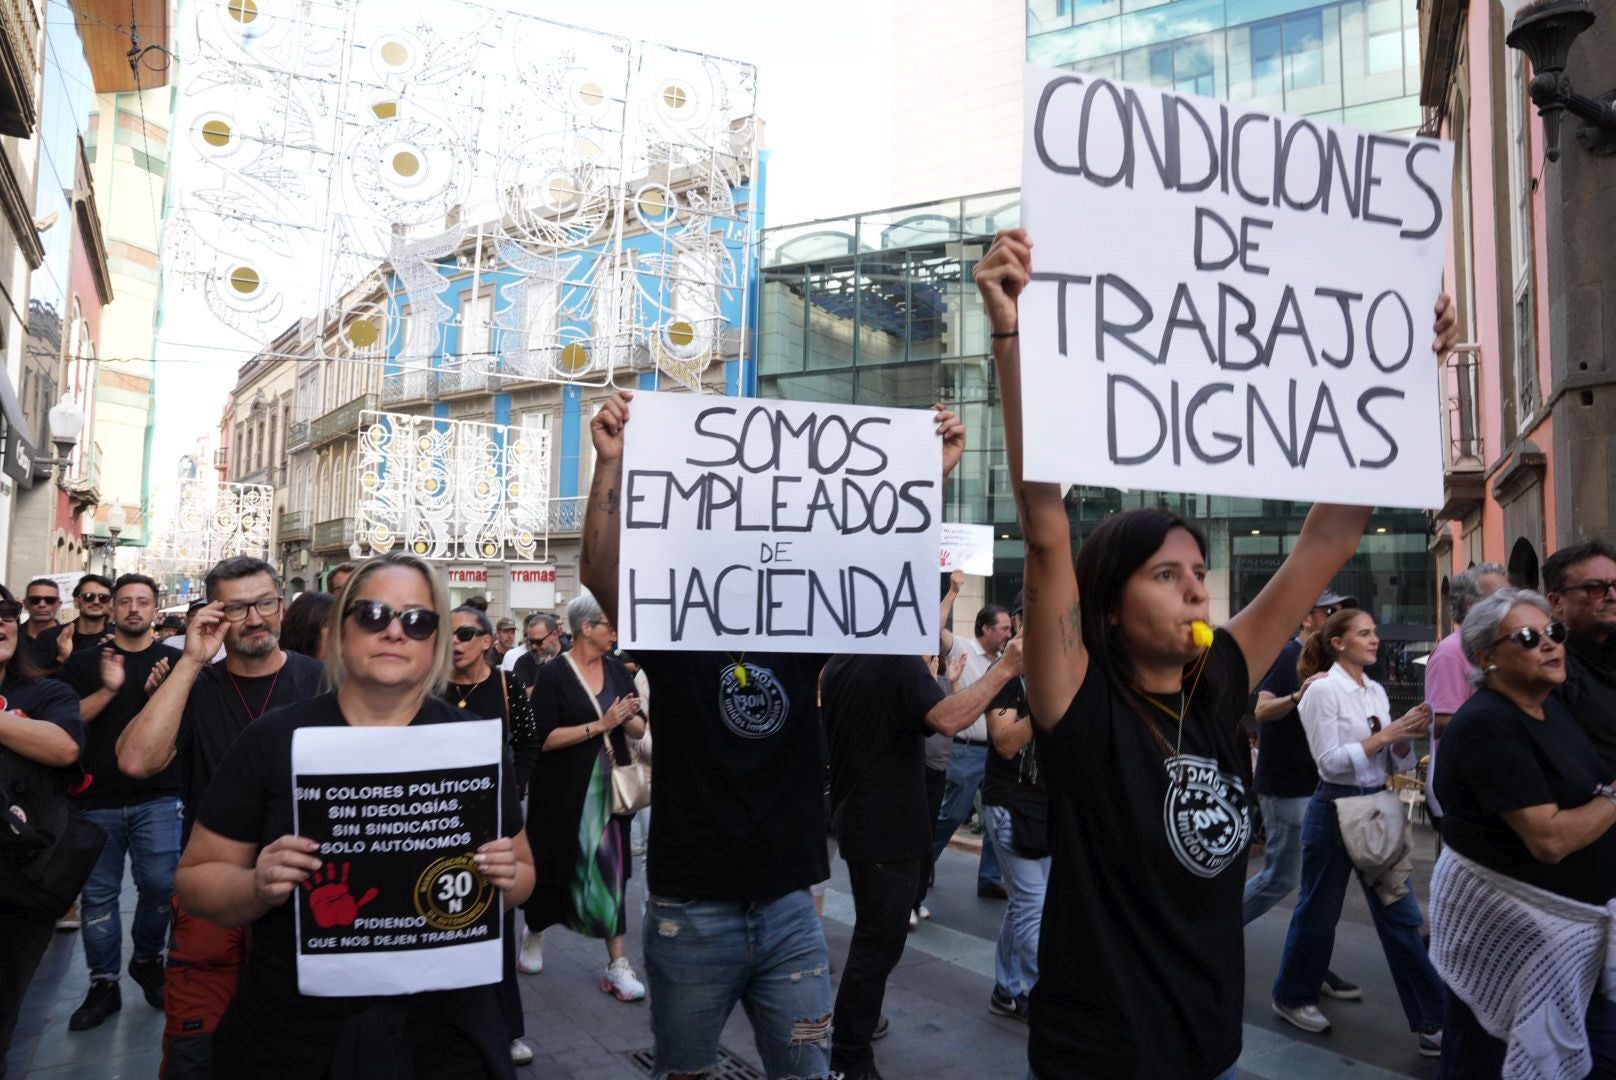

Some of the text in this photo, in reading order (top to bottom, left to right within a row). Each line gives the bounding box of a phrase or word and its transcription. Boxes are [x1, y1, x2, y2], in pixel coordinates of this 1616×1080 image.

[1034, 76, 1443, 239] CONDICIONES
[1194, 207, 1273, 276] DE
[1030, 272, 1414, 373] TRABAJO
[1107, 373, 1405, 469] DIGNAS
[686, 406, 891, 475] SOMOS
[626, 470, 934, 535] EMPLEADOS
[760, 542, 793, 563] DE
[630, 561, 926, 642] HACIENDA
[295, 787, 321, 800] SIN
[326, 785, 404, 800] COLORES
[328, 805, 356, 819] SIN
[320, 832, 472, 854] SOLO AUTÓNOMOS
[332, 824, 360, 836] SIN
[1178, 810, 1206, 861] unidos
[437, 871, 473, 900] 30
[448, 898, 462, 913] N
[308, 925, 488, 948] QUE NOS DEJEN TRABAJAR
[354, 916, 427, 929] PIDIENDO
